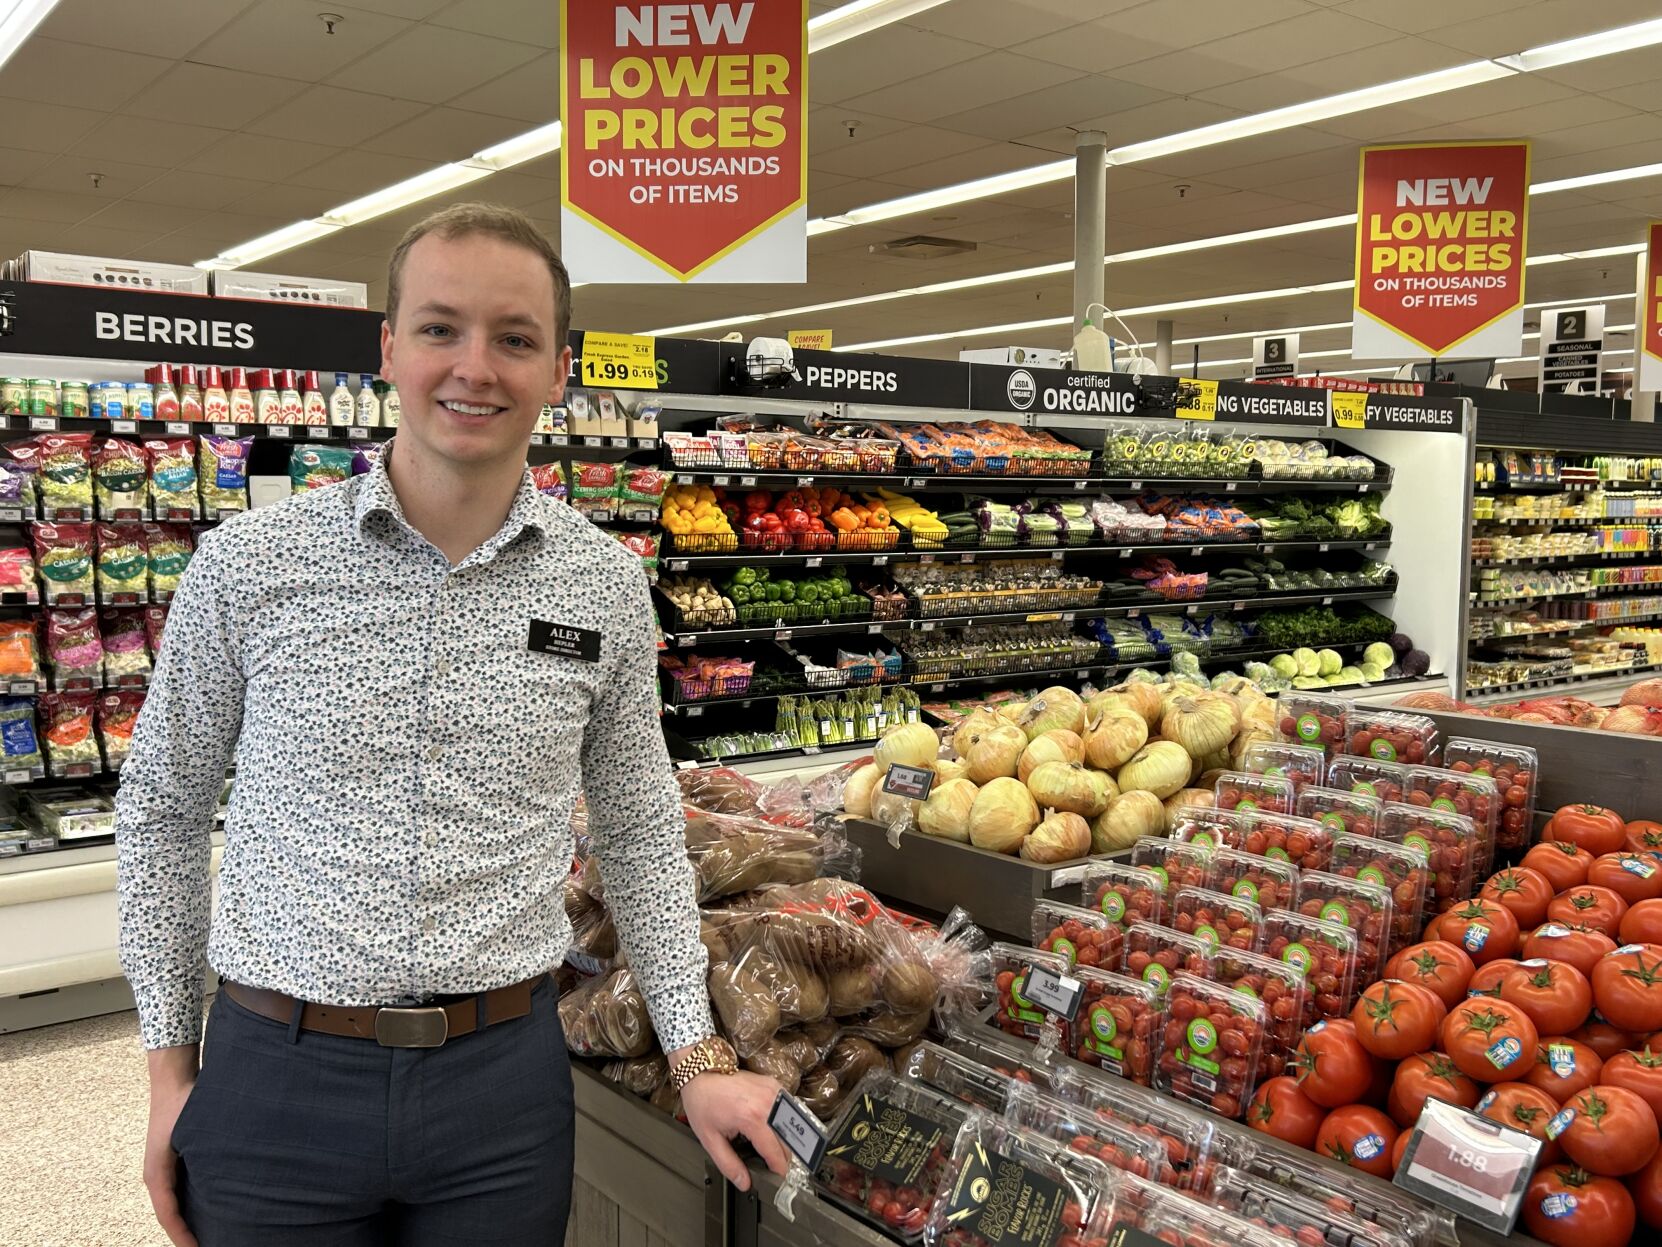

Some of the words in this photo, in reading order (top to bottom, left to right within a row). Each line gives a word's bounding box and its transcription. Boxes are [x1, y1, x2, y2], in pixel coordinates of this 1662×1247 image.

[615, 3, 754, 47] NEW
[580, 54, 790, 99] LOWER
[584, 105, 787, 149] PRICES
[588, 159, 624, 177] ON
[630, 156, 780, 177] THOUSANDS
[629, 185, 662, 204] OF
[669, 184, 739, 203] ITEMS
[1396, 177, 1494, 207] NEW
[1370, 210, 1516, 241] LOWER
[1371, 244, 1512, 273] PRICES
[1373, 278, 1399, 291] ON
[1404, 276, 1507, 290] THOUSANDS
[1401, 296, 1424, 308] OF
[1429, 294, 1478, 307] ITEMS
[95, 311, 255, 350] BERRIES
[1563, 316, 1577, 334] 2
[795, 335, 824, 344] COMPARE
[1556, 343, 1593, 352] SEASONAL
[1269, 343, 1279, 358] 3
[586, 362, 629, 380] 1.99
[632, 369, 654, 378] 0.19
[807, 366, 897, 392] PEPPERS
[1067, 374, 1110, 388] certified
[1015, 380, 1029, 388] USDA
[1043, 389, 1135, 414] ORGANIC
[1217, 396, 1238, 413] NG
[1242, 396, 1324, 417] VEGETABLES
[1335, 409, 1353, 421] 0.99
[1384, 406, 1453, 425] VEGETABLES
[550, 627, 581, 642] ALEX
[1042, 980, 1060, 993] 3.99
[789, 1116, 805, 1136] 5.49
[854, 1107, 897, 1165] SUGAR
[864, 1110, 907, 1170] BOMBS
[1448, 1143, 1488, 1173] 1.88
[977, 1160, 1013, 1234] SUGAR
[987, 1164, 1024, 1241] BOMBS
[1007, 1207, 1025, 1235] FLAVOR
[1017, 1183, 1033, 1210] ROCKS
